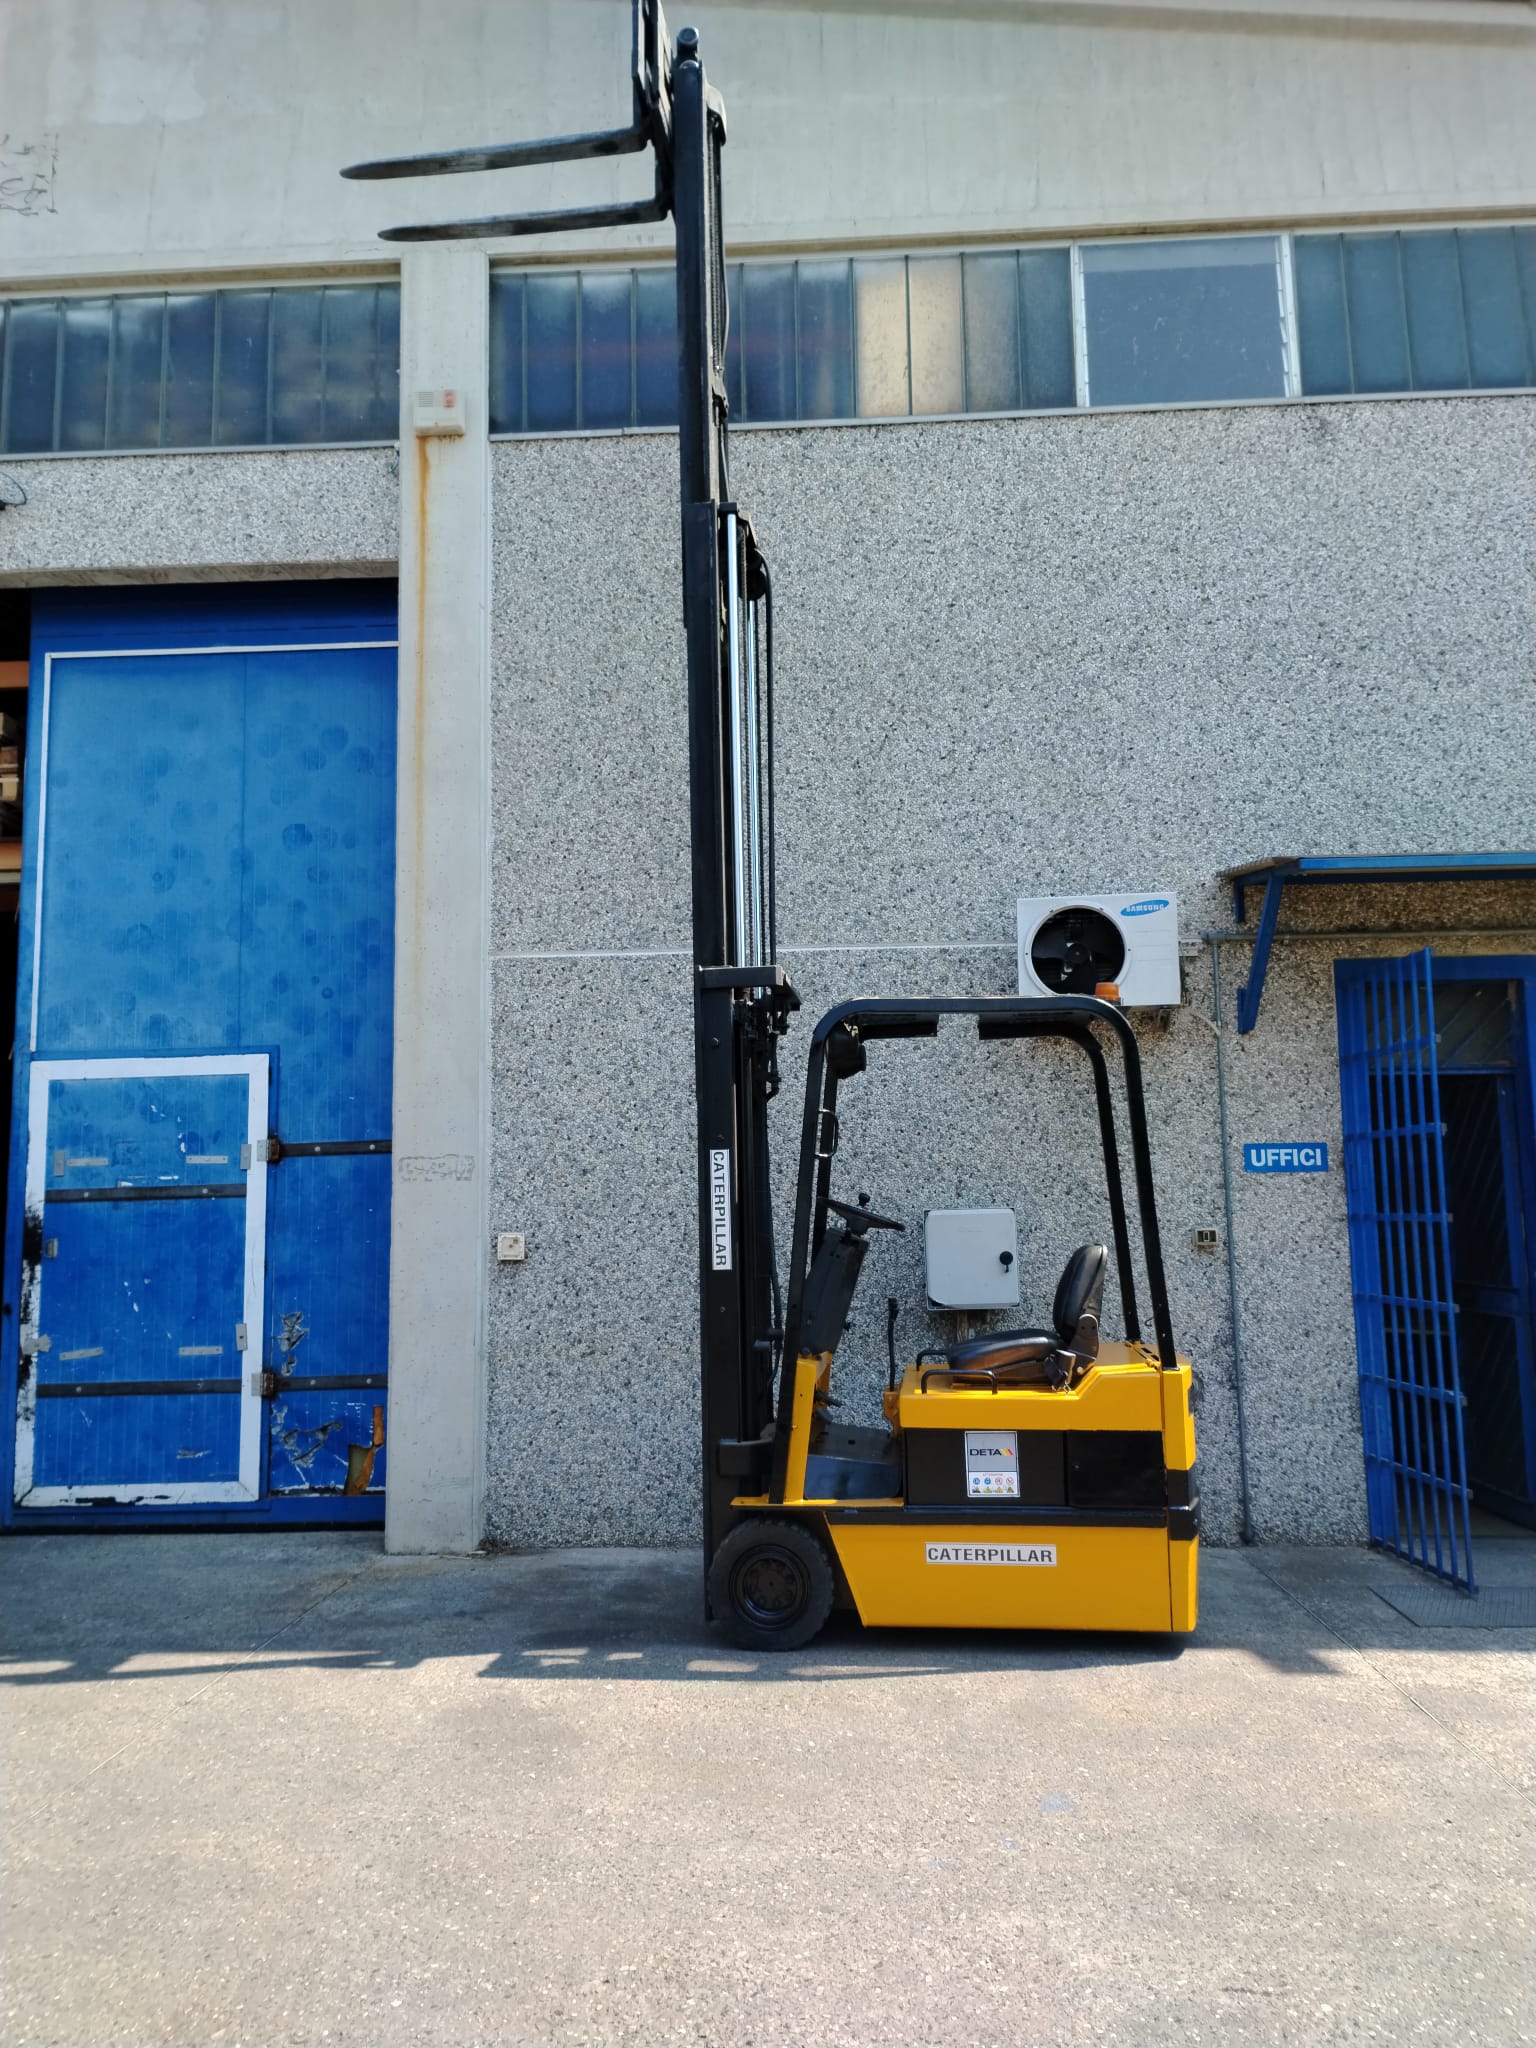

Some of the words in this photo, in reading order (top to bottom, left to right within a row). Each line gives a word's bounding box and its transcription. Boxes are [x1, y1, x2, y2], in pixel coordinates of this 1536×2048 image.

[1126, 903, 1165, 912] SAMSUNG
[1250, 1148, 1322, 1167] UFFICI
[713, 1151, 727, 1266] CATERPILLAR
[969, 1448, 1002, 1456] DETA
[928, 1547, 1052, 1563] CATERPILLAR
